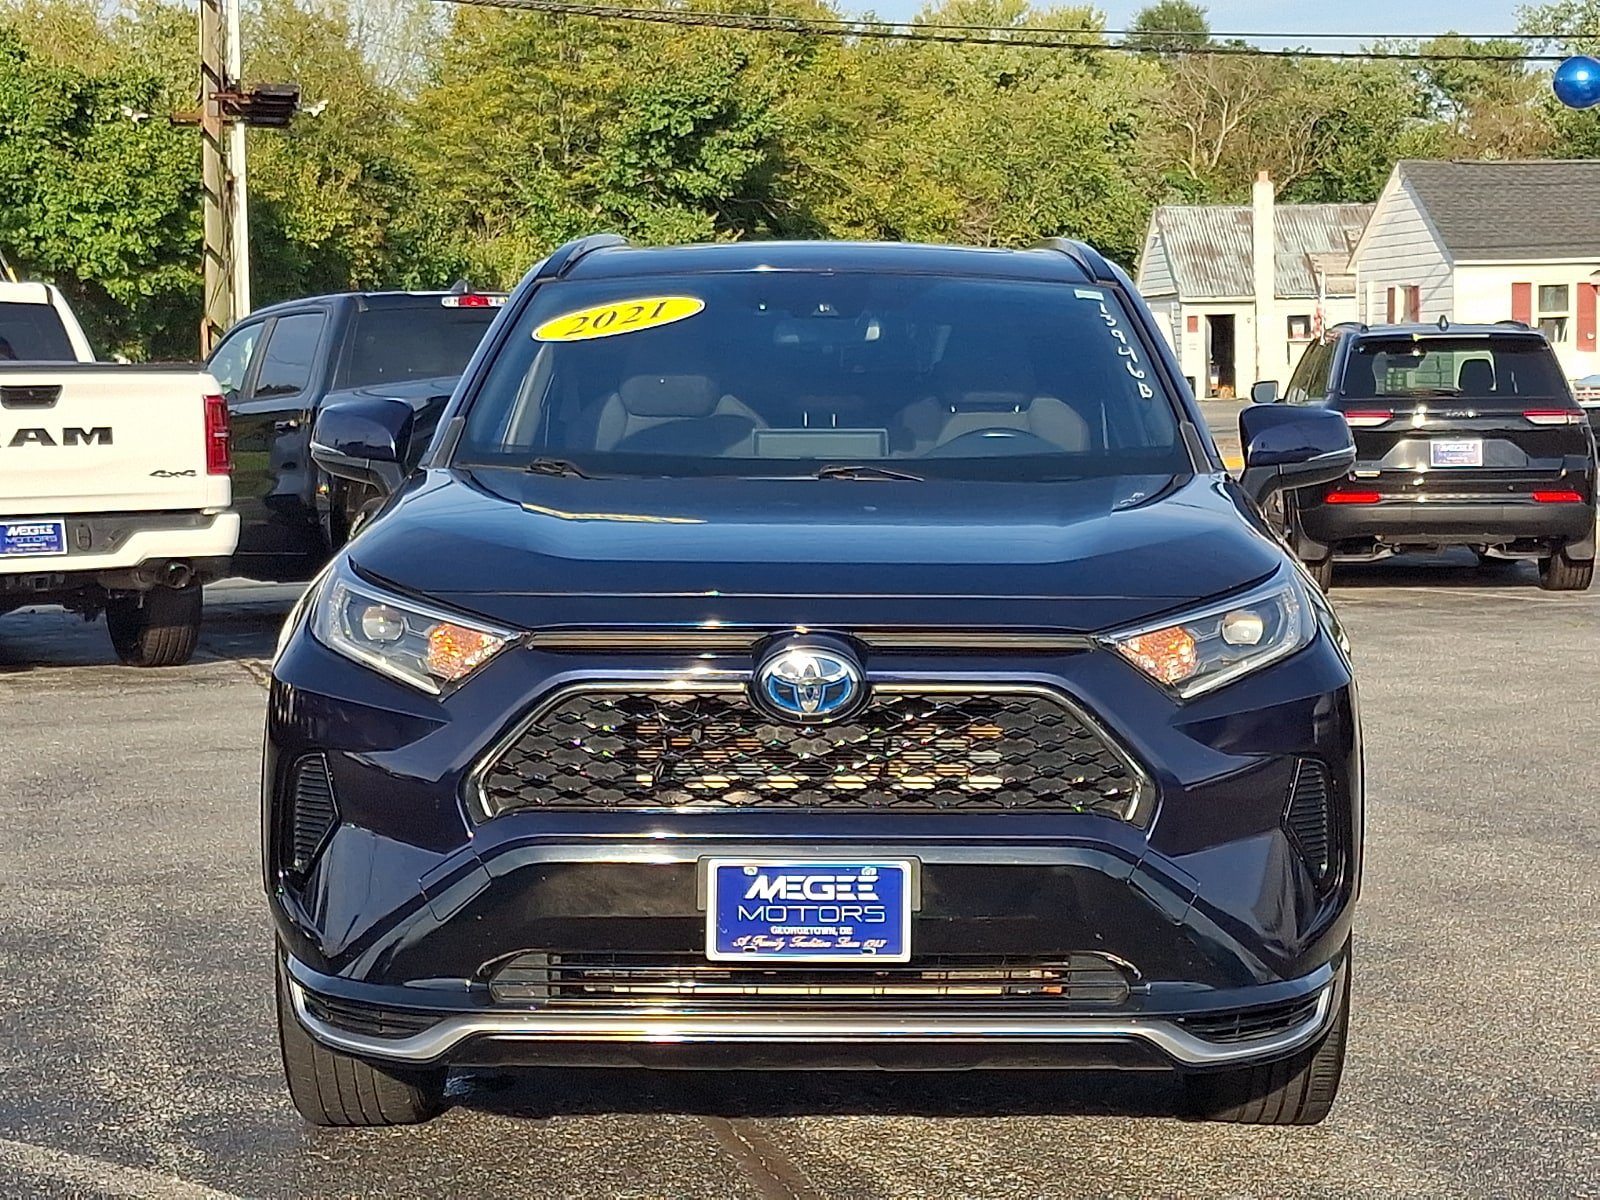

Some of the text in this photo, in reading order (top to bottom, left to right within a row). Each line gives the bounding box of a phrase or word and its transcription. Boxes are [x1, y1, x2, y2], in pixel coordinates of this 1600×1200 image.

[564, 301, 667, 337] 2021
[0, 426, 114, 448] AM
[744, 875, 880, 903] MEGEE
[737, 905, 886, 923] MOTORS
